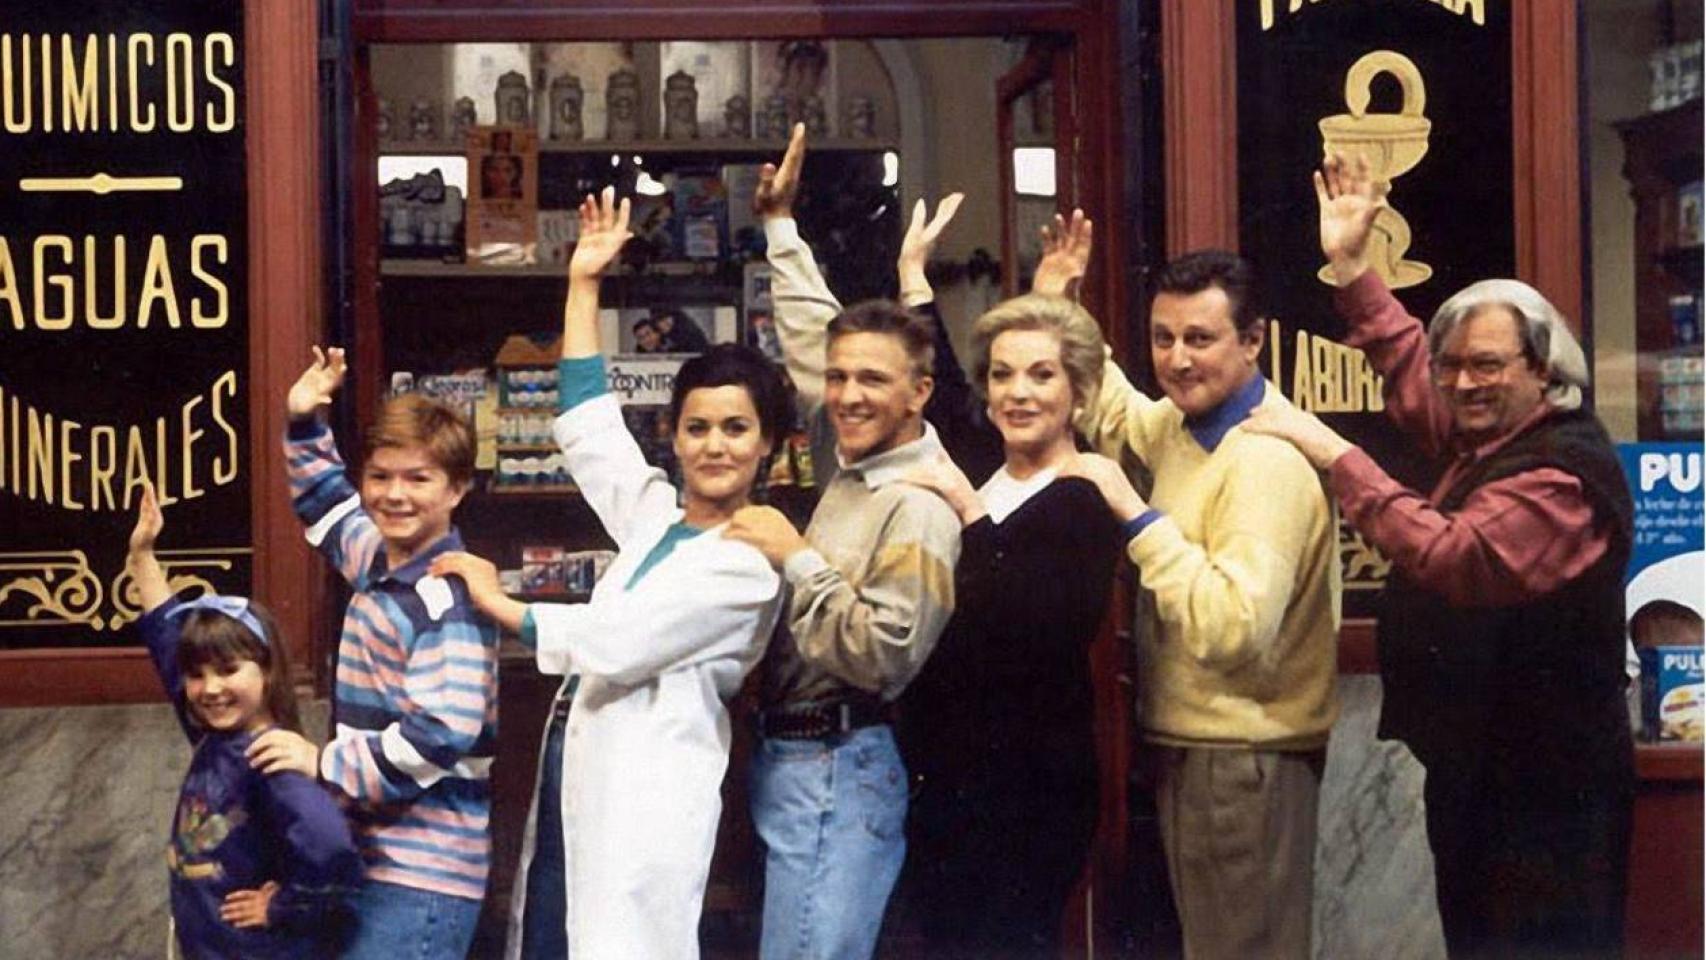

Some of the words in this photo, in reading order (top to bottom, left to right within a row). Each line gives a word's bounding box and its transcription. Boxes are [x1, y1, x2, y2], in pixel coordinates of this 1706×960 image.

[0, 33, 235, 134] UIMICOS
[0, 234, 229, 331] AGUAS
[1270, 318, 1385, 412] LABOR
[0, 369, 238, 511] INERALES
[1640, 452, 1704, 493] PU
